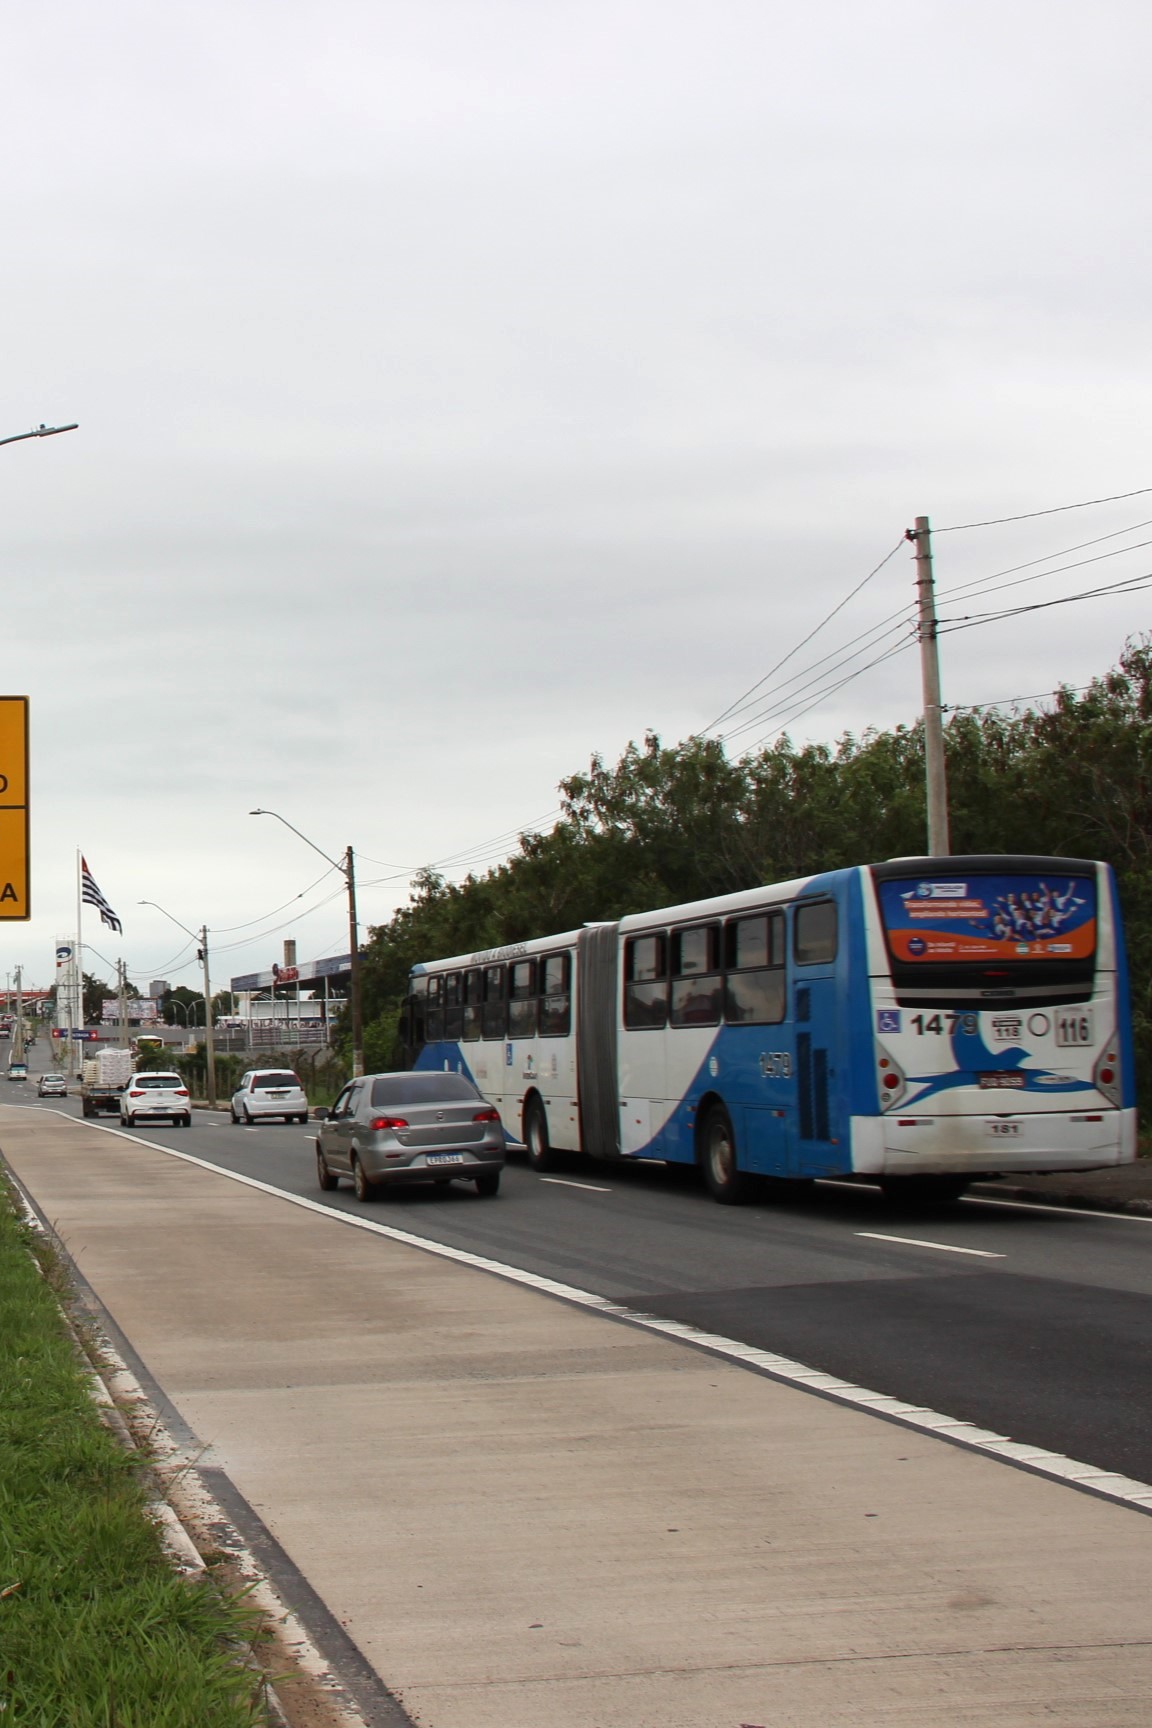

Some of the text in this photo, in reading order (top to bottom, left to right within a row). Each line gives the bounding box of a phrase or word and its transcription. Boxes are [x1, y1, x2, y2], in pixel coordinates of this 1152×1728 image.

[910, 1013, 979, 1036] 1479
[1059, 1016, 1089, 1042] 116
[759, 1051, 792, 1079] 1479
